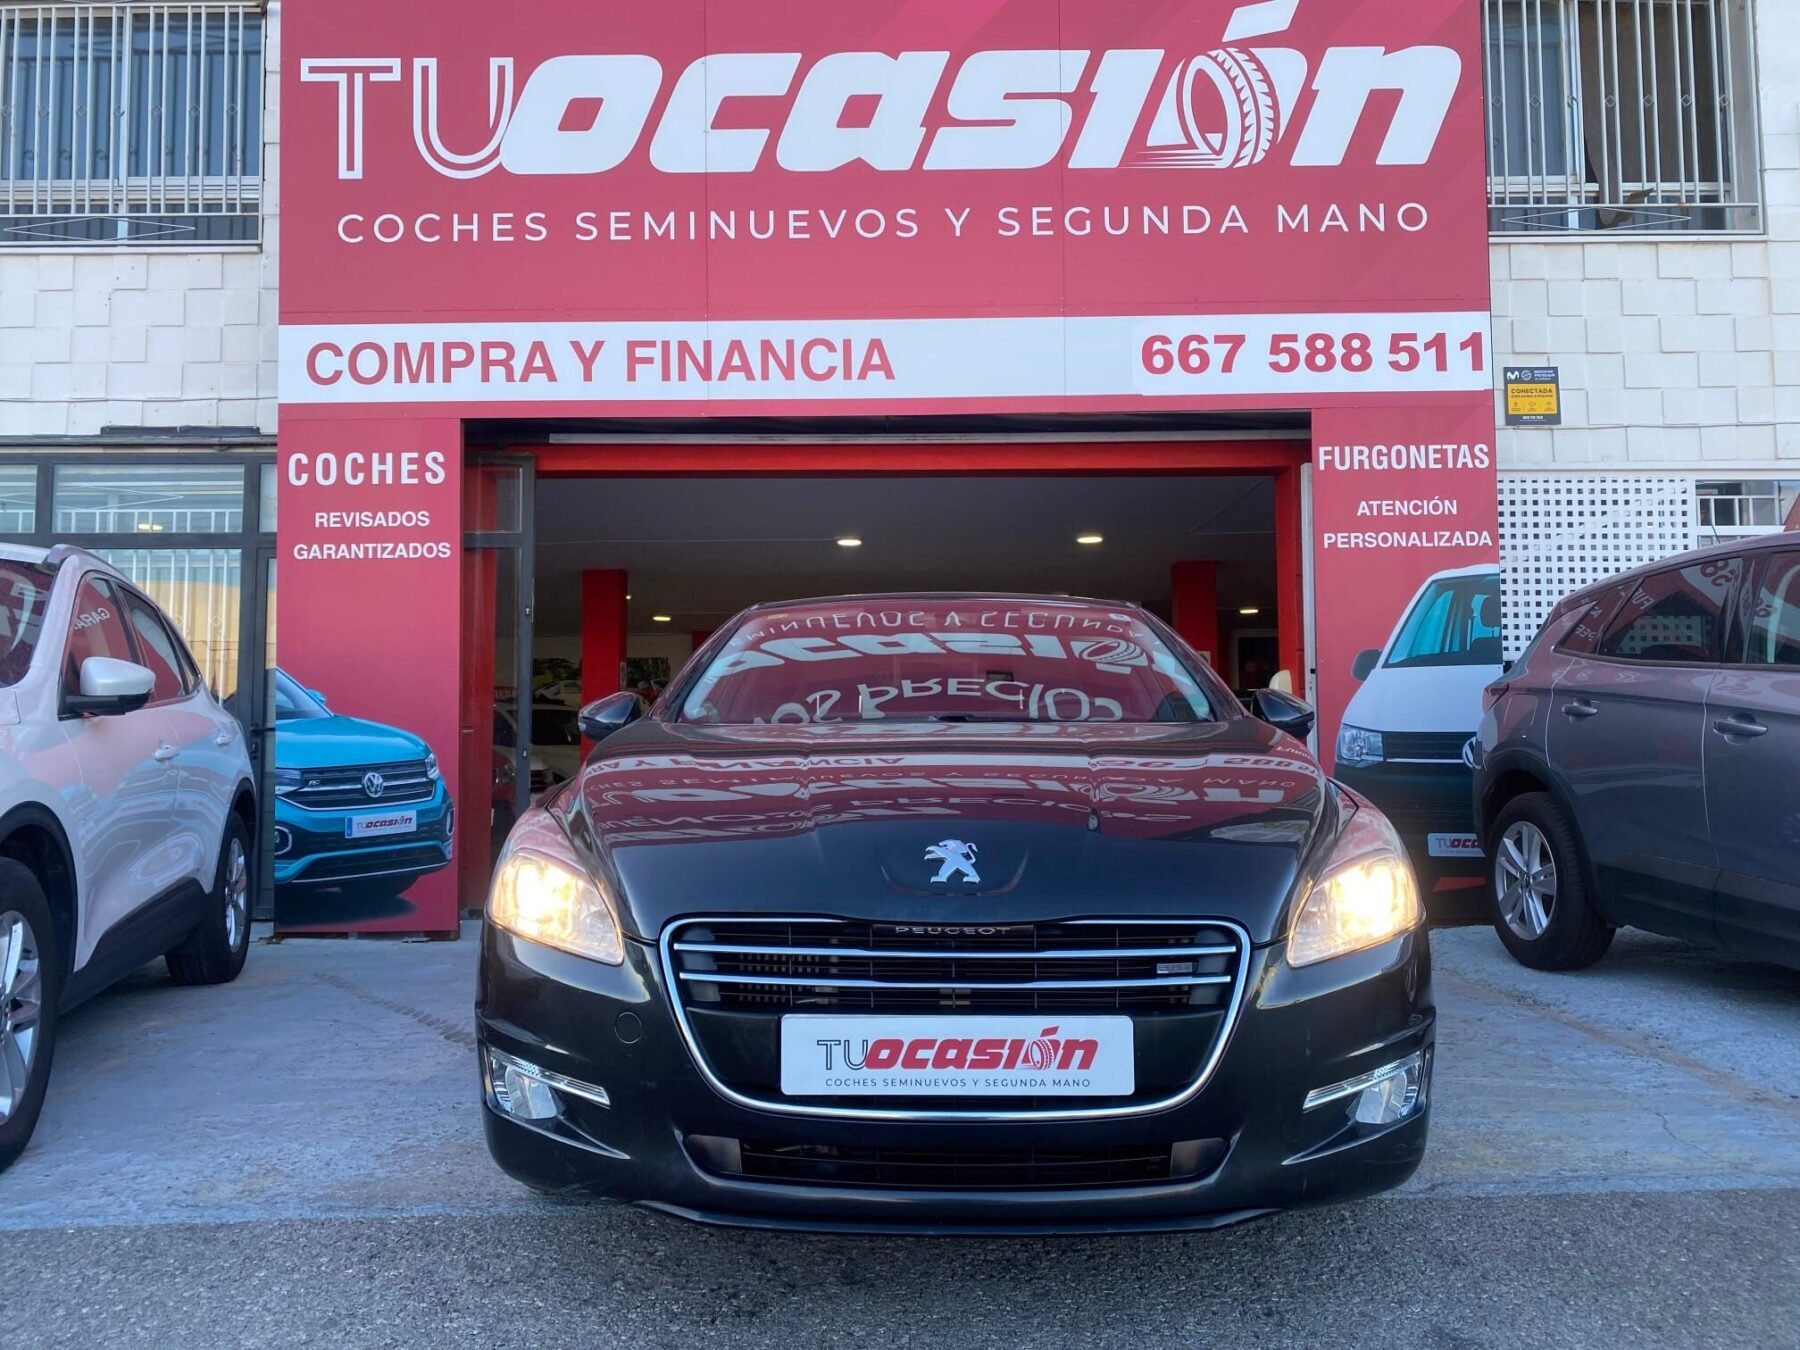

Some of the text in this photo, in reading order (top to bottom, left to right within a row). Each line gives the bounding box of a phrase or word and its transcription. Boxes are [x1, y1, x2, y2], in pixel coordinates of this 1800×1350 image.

[337, 202, 1428, 243] COCHES SEMINUEVOS Y SEGUNDA MANO
[306, 338, 894, 385] COMPRA Y FINANCIA
[1141, 332, 1484, 375] 667 588 511
[1318, 443, 1490, 471] FURGONETAS
[288, 451, 446, 486] COCHES
[1356, 495, 1458, 516] ATENCIÓN
[315, 510, 430, 528] REVISADOS
[1323, 530, 1493, 549] PERSONALIZADA
[293, 542, 451, 560] GARANTIZADOS
[895, 926, 1011, 935] PEUGEOT
[825, 1078, 1091, 1088] COCHES SEMINUEVOS Y SEGUNDA MANO
